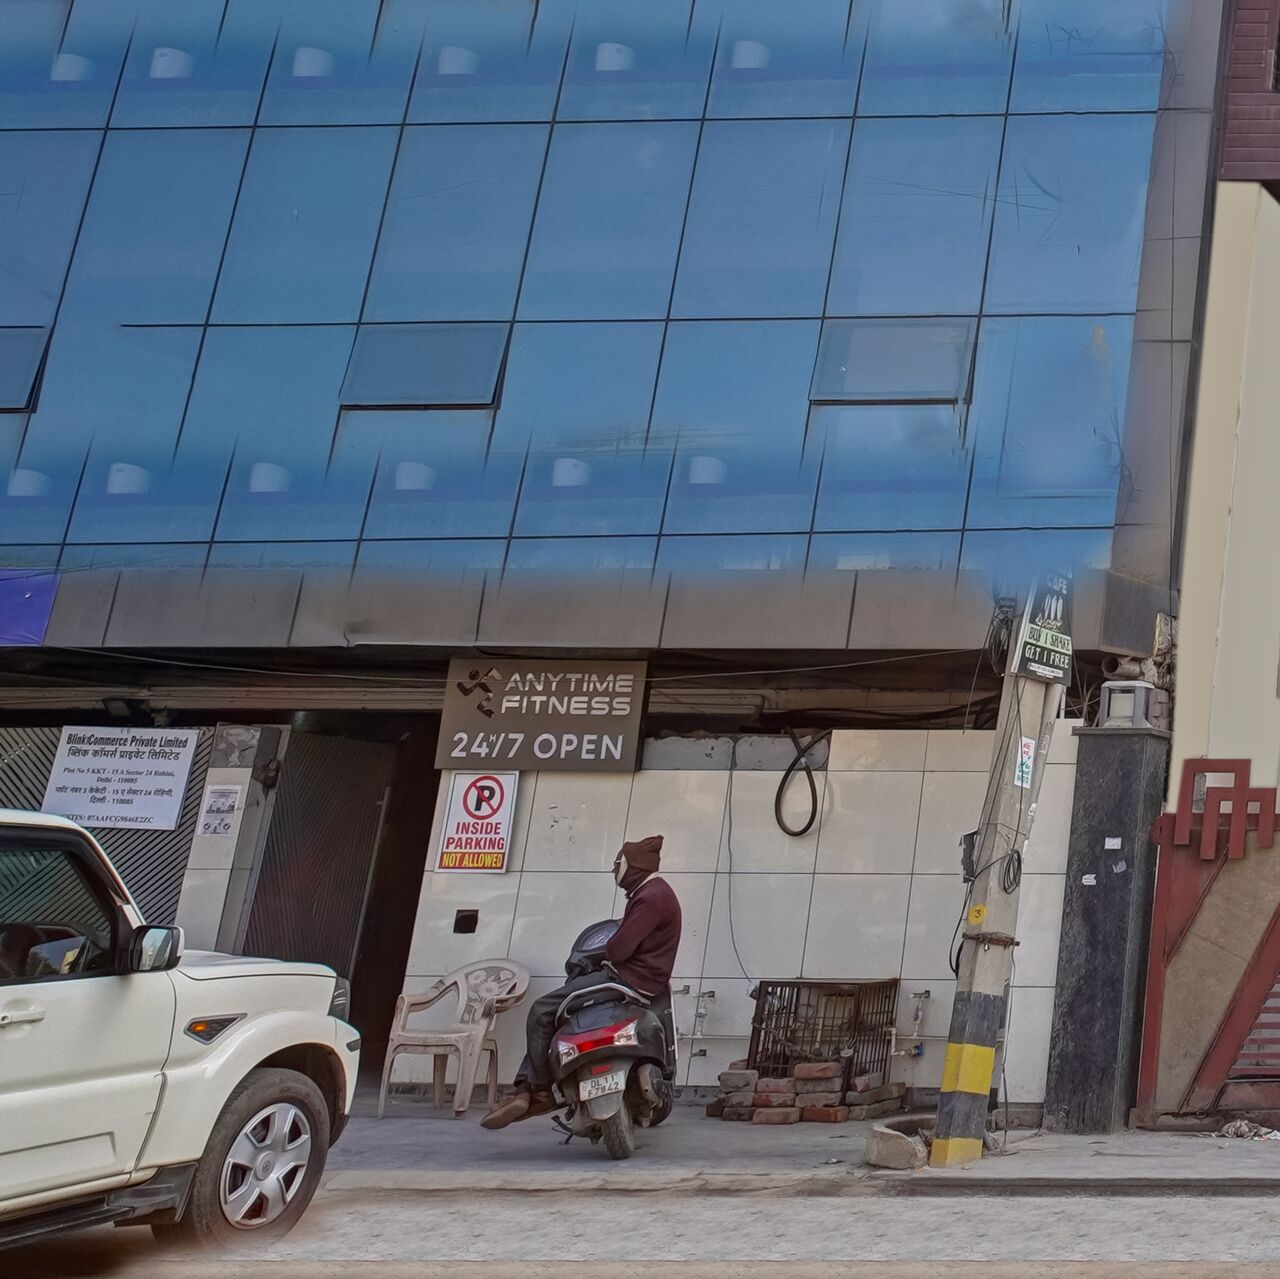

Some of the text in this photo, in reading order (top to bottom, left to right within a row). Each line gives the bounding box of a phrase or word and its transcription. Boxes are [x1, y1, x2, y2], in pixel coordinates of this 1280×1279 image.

[1025, 645, 1041, 660] GET
[1050, 652, 1069, 668] FREE
[504, 672, 634, 692] ANYTIME
[500, 696, 632, 716] FITNESS
[130, 735, 158, 747] Private
[159, 736, 189, 748] Limited
[533, 733, 624, 760] OPEN
[455, 822, 502, 835] INSIDE
[445, 837, 505, 850] PARKING
[442, 852, 503, 868] NOT ALLOWED
